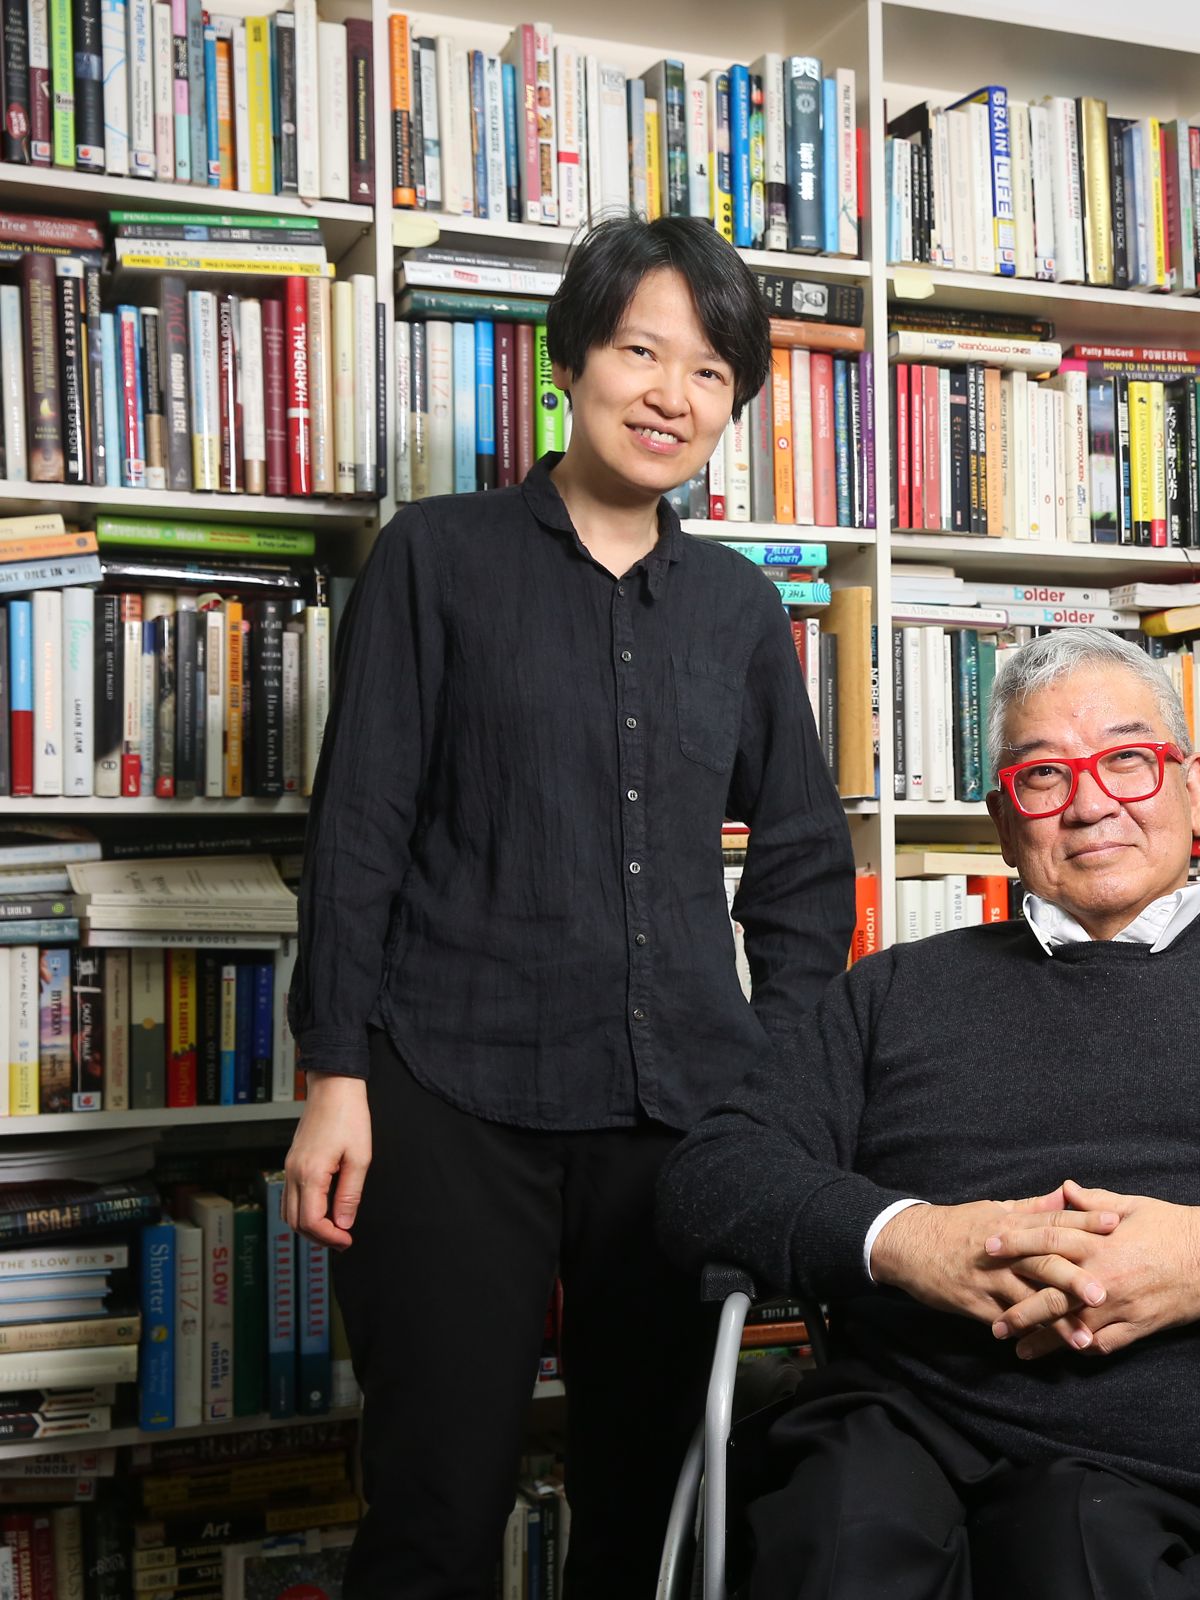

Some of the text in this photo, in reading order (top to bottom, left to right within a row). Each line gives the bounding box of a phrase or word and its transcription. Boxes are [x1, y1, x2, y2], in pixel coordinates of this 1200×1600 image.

[992, 91, 1011, 214] BRAIN LIFE
[1115, 175, 1123, 203] MADE
[1, 221, 28, 233] Tree
[1116, 221, 1124, 249] STICK
[32, 245, 72, 255] Hammer
[220, 302, 232, 337] BLOOD
[292, 322, 308, 402] HARDBALL
[1081, 346, 1189, 362] Patty McCord POWERFUL
[63, 280, 78, 454] RELEASE 2.0 ESTHER DYSON
[171, 353, 185, 398] GORDON
[968, 368, 976, 382] THE
[1103, 362, 1196, 374] HOW TO FIX THE FUTURE
[969, 384, 977, 408] CRAZY
[172, 401, 186, 434] REECE
[978, 411, 986, 431] BUSY
[979, 456, 987, 475] ZENA
[1077, 426, 1085, 482] CRYPTOQUEEN
[766, 553, 801, 564] GANNETT
[771, 545, 799, 555] ALLEN
[787, 589, 806, 599] THE
[1012, 586, 1066, 604] bolder
[105, 602, 114, 621] THE
[1042, 608, 1095, 624] bolder
[105, 622, 114, 643] RITE
[954, 894, 962, 921] WORLD
[161, 935, 238, 945] WARM BODIES
[866, 907, 876, 953] UTOPIA
[51, 990, 62, 1036] HYPERION
[25, 1207, 72, 1234] PUSH
[0, 1254, 97, 1271] THE SLOW FIX
[240, 1233, 258, 1288] Expert
[150, 1244, 169, 1315] Shorter
[212, 1246, 229, 1306] SLOW
[221, 1349, 229, 1381] CARL
[202, 1521, 231, 1539] Art
